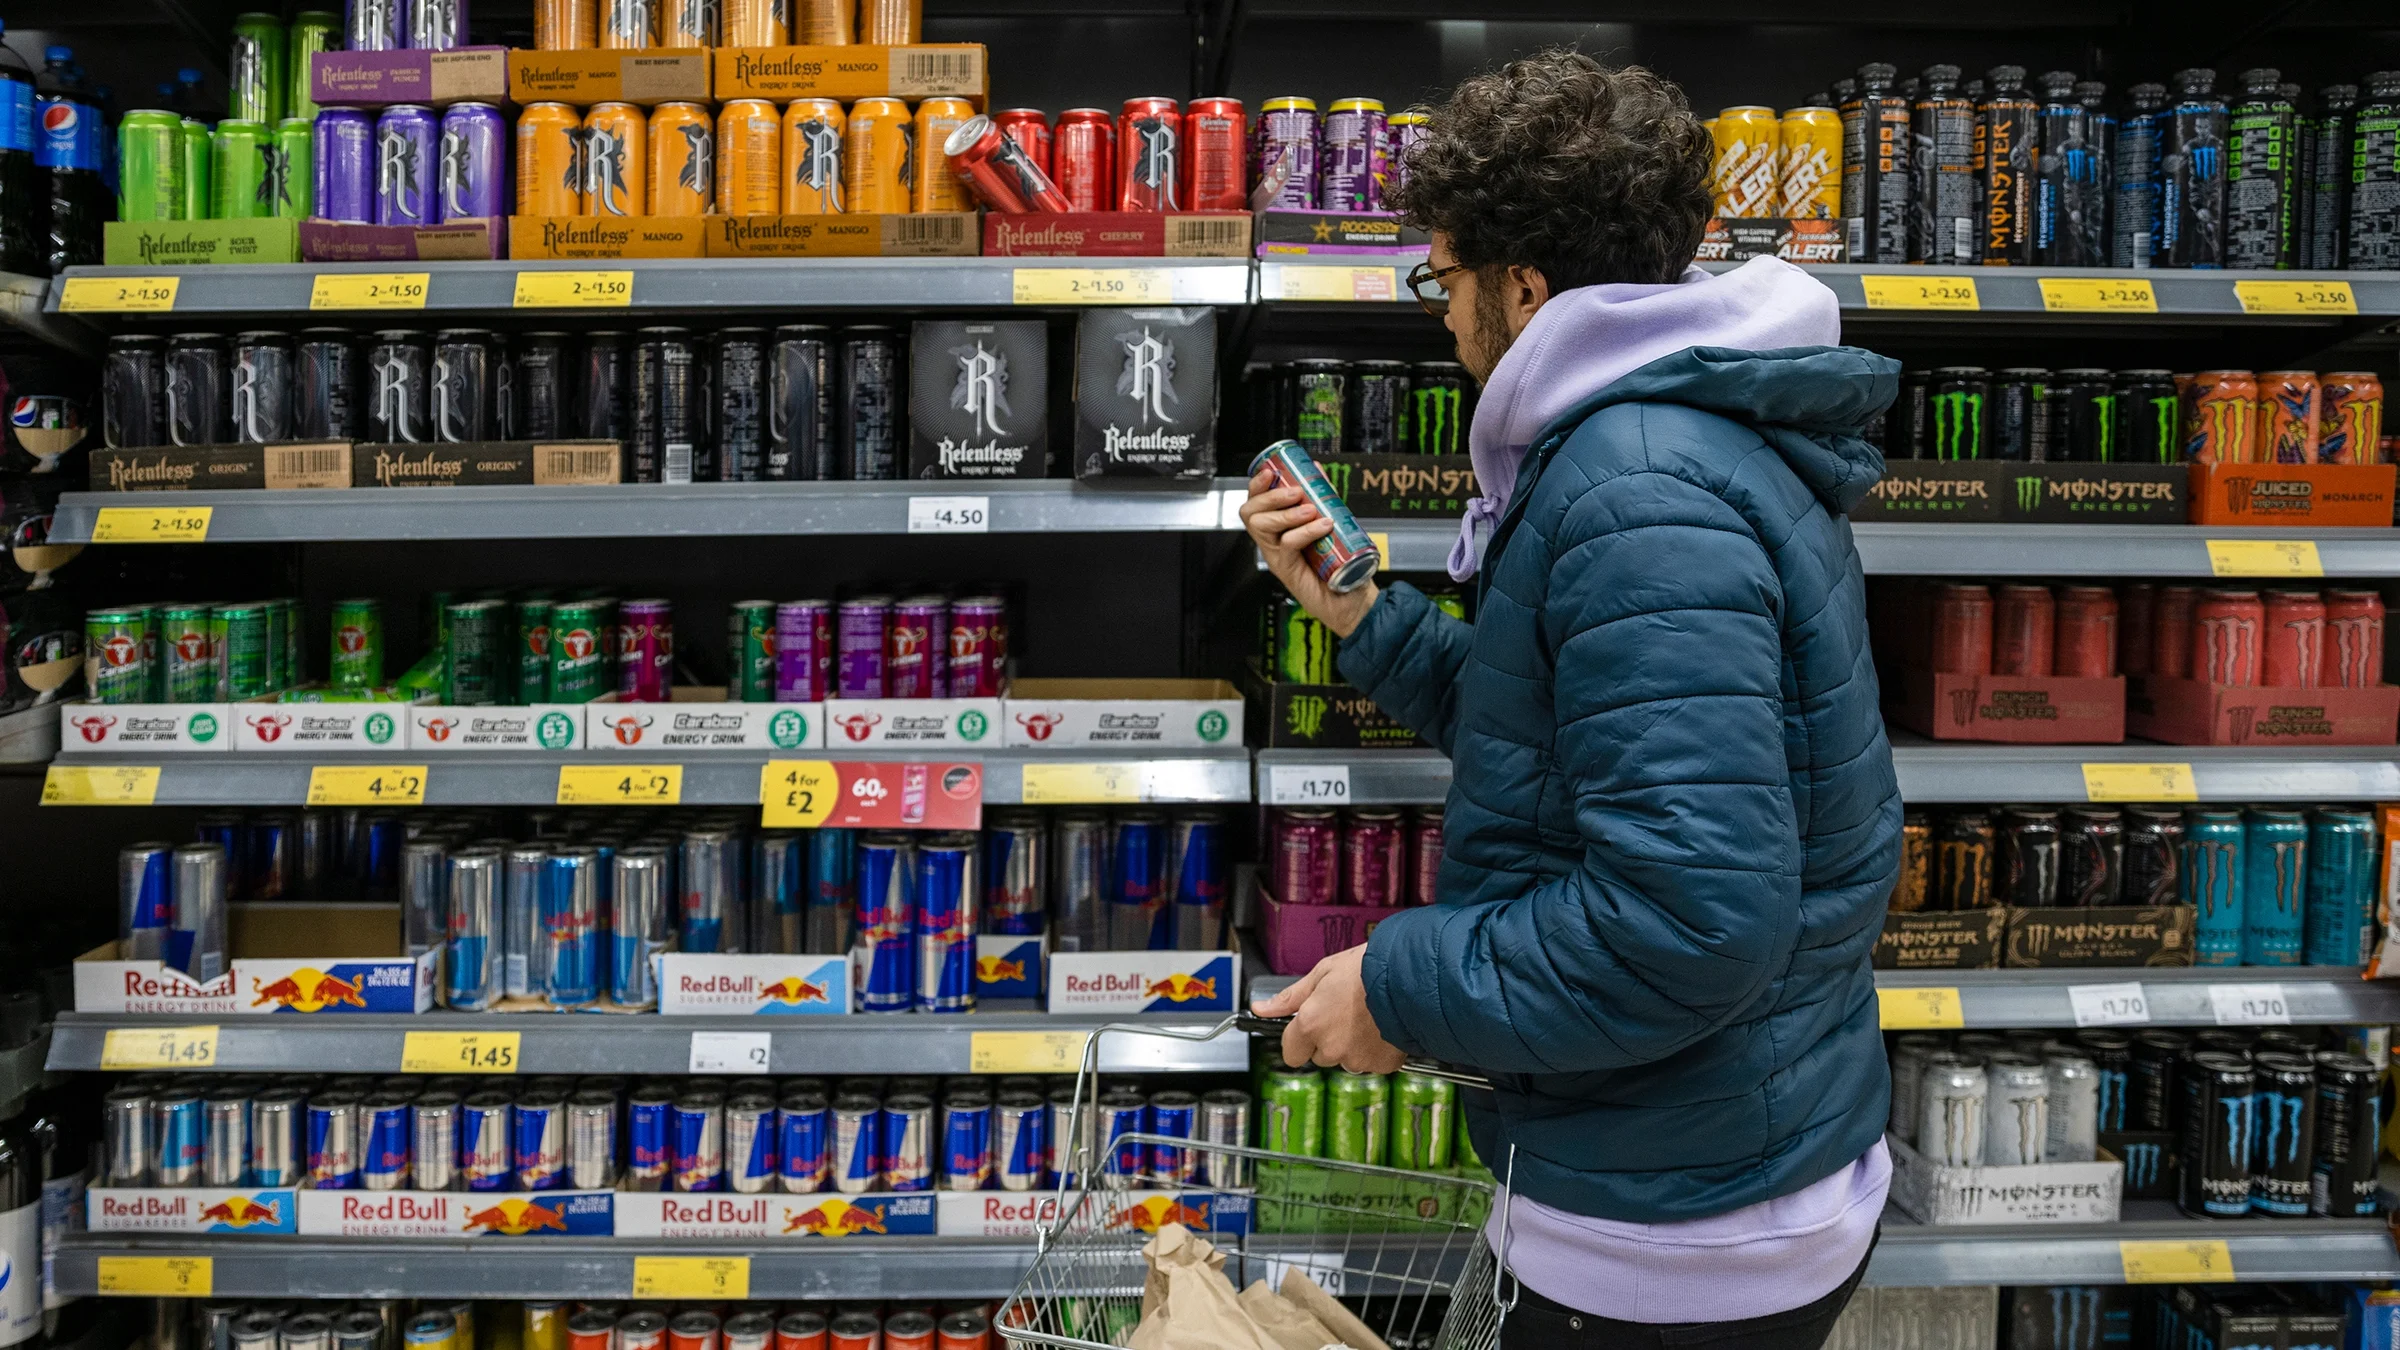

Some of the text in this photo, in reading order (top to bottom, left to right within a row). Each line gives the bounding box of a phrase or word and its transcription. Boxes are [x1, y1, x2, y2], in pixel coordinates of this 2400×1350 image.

[321, 65, 383, 90] Relentless
[520, 63, 580, 90] Relentless
[735, 51, 878, 90] Relentless MANGO
[1987, 120, 2012, 248] MONSTER
[542, 221, 682, 257] Relentless MANGO
[724, 217, 869, 250] Relentless MANGO
[995, 219, 1144, 256] Relentless CHERRY
[138, 229, 218, 264] Relentless
[1776, 243, 1844, 260] ALERT
[118, 288, 170, 300] 2 £1.50
[370, 285, 422, 297] 2 £1.50
[572, 282, 626, 294] 2 £1.50
[1071, 280, 1124, 292] 2 £1.50
[1920, 287, 1971, 299] 2 £2.50
[2098, 290, 2149, 301] 2 £2.50
[2296, 292, 2347, 303] 2 £2.50
[1126, 326, 1179, 424] R
[960, 339, 1012, 436] R
[1102, 423, 1190, 463] Relentless
[937, 436, 1024, 475] Relentless
[1127, 453, 1183, 463] ENERGY DRINK
[109, 454, 247, 491] Relentless ORIGIN
[374, 450, 516, 486] Relentless ORIGIN
[961, 466, 1016, 475] ENERGY DRINK
[1867, 476, 1988, 499] MONSTER
[2049, 478, 2175, 501] MONSTER
[2252, 481, 2383, 501] JUICED MONARCH
[1886, 501, 1965, 510] ENERGY
[2070, 502, 2152, 512] ENERGY
[151, 518, 203, 530] 2 £1.50
[934, 509, 983, 524] £4.50
[2269, 706, 2325, 719] PUNCH
[674, 714, 742, 730] Carabao
[2256, 721, 2333, 736] MONSTER
[294, 732, 353, 740] ENERGY DRINK
[462, 734, 528, 743] ENERGY DRINK
[662, 734, 746, 744] ENERGY DRINK
[884, 732, 946, 740] ENERGY DRINK
[368, 777, 382, 795] 4
[400, 777, 419, 795] £2
[618, 777, 631, 794] 4
[650, 776, 669, 795] £2
[785, 771, 819, 786] 4 for
[852, 778, 888, 799] 60p
[1303, 780, 1345, 796] £1.70
[786, 791, 813, 814] £2
[1881, 930, 1980, 948] MONSTER
[2053, 922, 2160, 942] MONSTER
[680, 975, 753, 992] Red Bull
[1066, 974, 1139, 992] Red Bull
[125, 1001, 237, 1013] ENERGY DRINK
[2102, 997, 2144, 1017] £1.70
[2242, 1001, 2284, 1017] £1.70
[159, 1040, 209, 1062] £1.45
[461, 1047, 512, 1066] £1.45
[750, 1048, 766, 1065] £2
[1989, 1183, 2100, 1203] MONSTER
[103, 1196, 186, 1215] Red Bull
[343, 1197, 446, 1221] Red Bull
[662, 1199, 768, 1223] Red Bull
[984, 1197, 1034, 1221] Red
[103, 1219, 188, 1228] SUGARFREE
[342, 1225, 448, 1236] ENERGY DRINK
[661, 1228, 768, 1238] ENERGY DRINK
